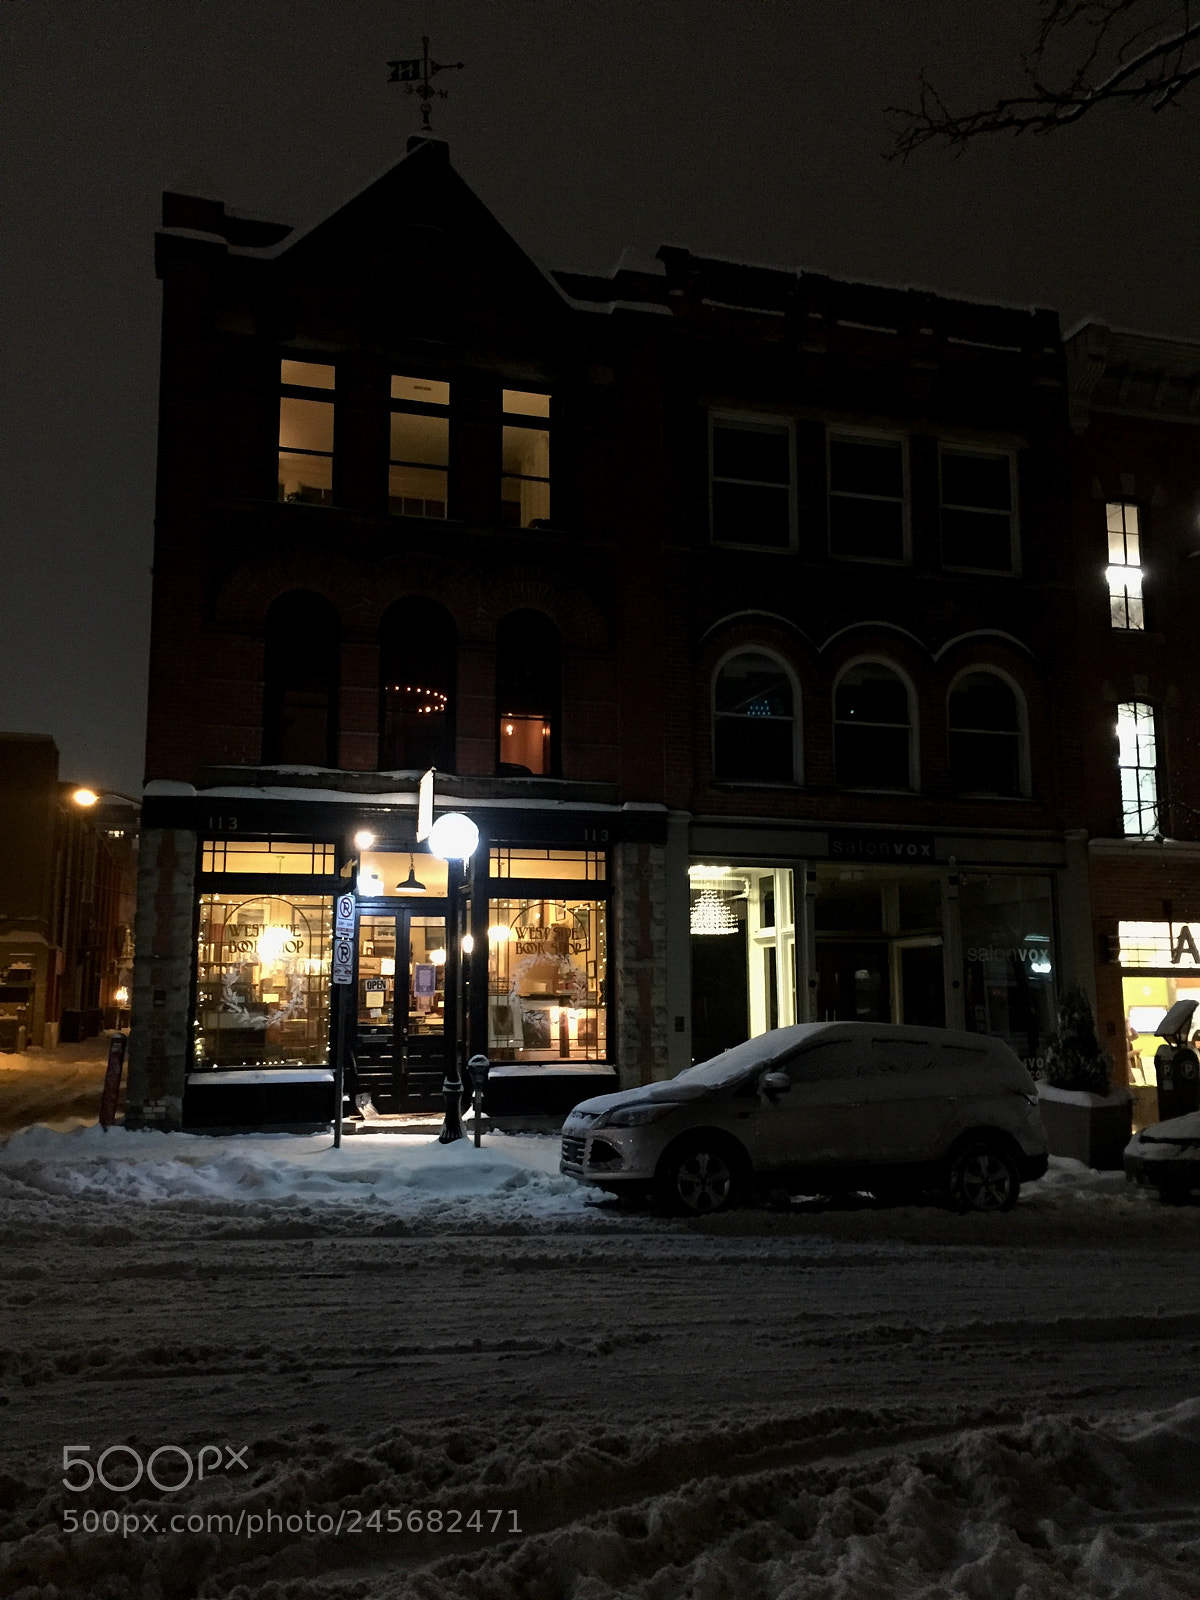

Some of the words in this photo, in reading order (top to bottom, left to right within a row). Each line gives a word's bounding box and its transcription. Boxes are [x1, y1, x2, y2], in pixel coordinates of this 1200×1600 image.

[208, 815, 238, 830] 113
[584, 828, 609, 842] 113
[515, 926, 550, 940] WEST
[366, 980, 387, 990] OPEN
